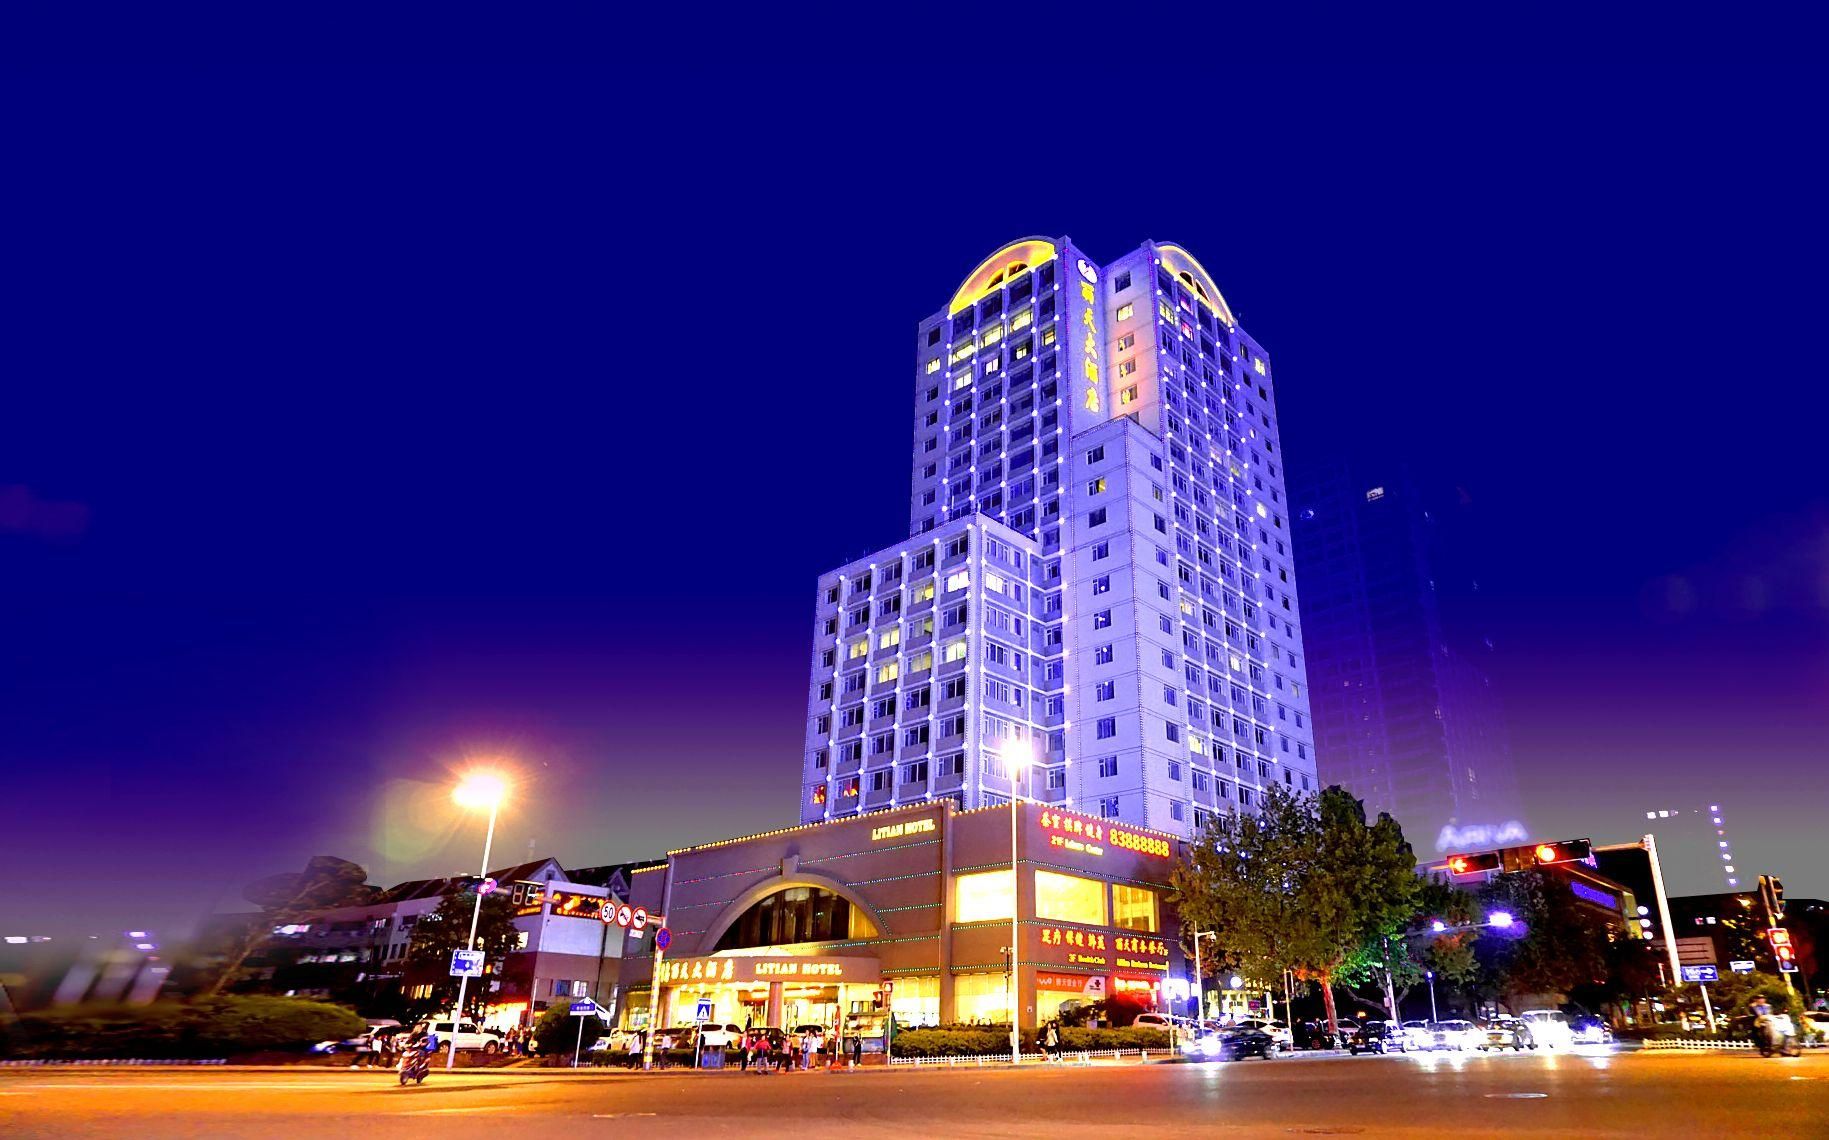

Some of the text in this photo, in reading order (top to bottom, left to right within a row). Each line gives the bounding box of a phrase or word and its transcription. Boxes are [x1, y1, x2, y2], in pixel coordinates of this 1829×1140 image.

[871, 818, 936, 841] LITIAN HOTEL
[1109, 828, 1170, 857] 83888888
[603, 906, 614, 919] 50
[755, 962, 842, 975] LITIAN HOTEL
